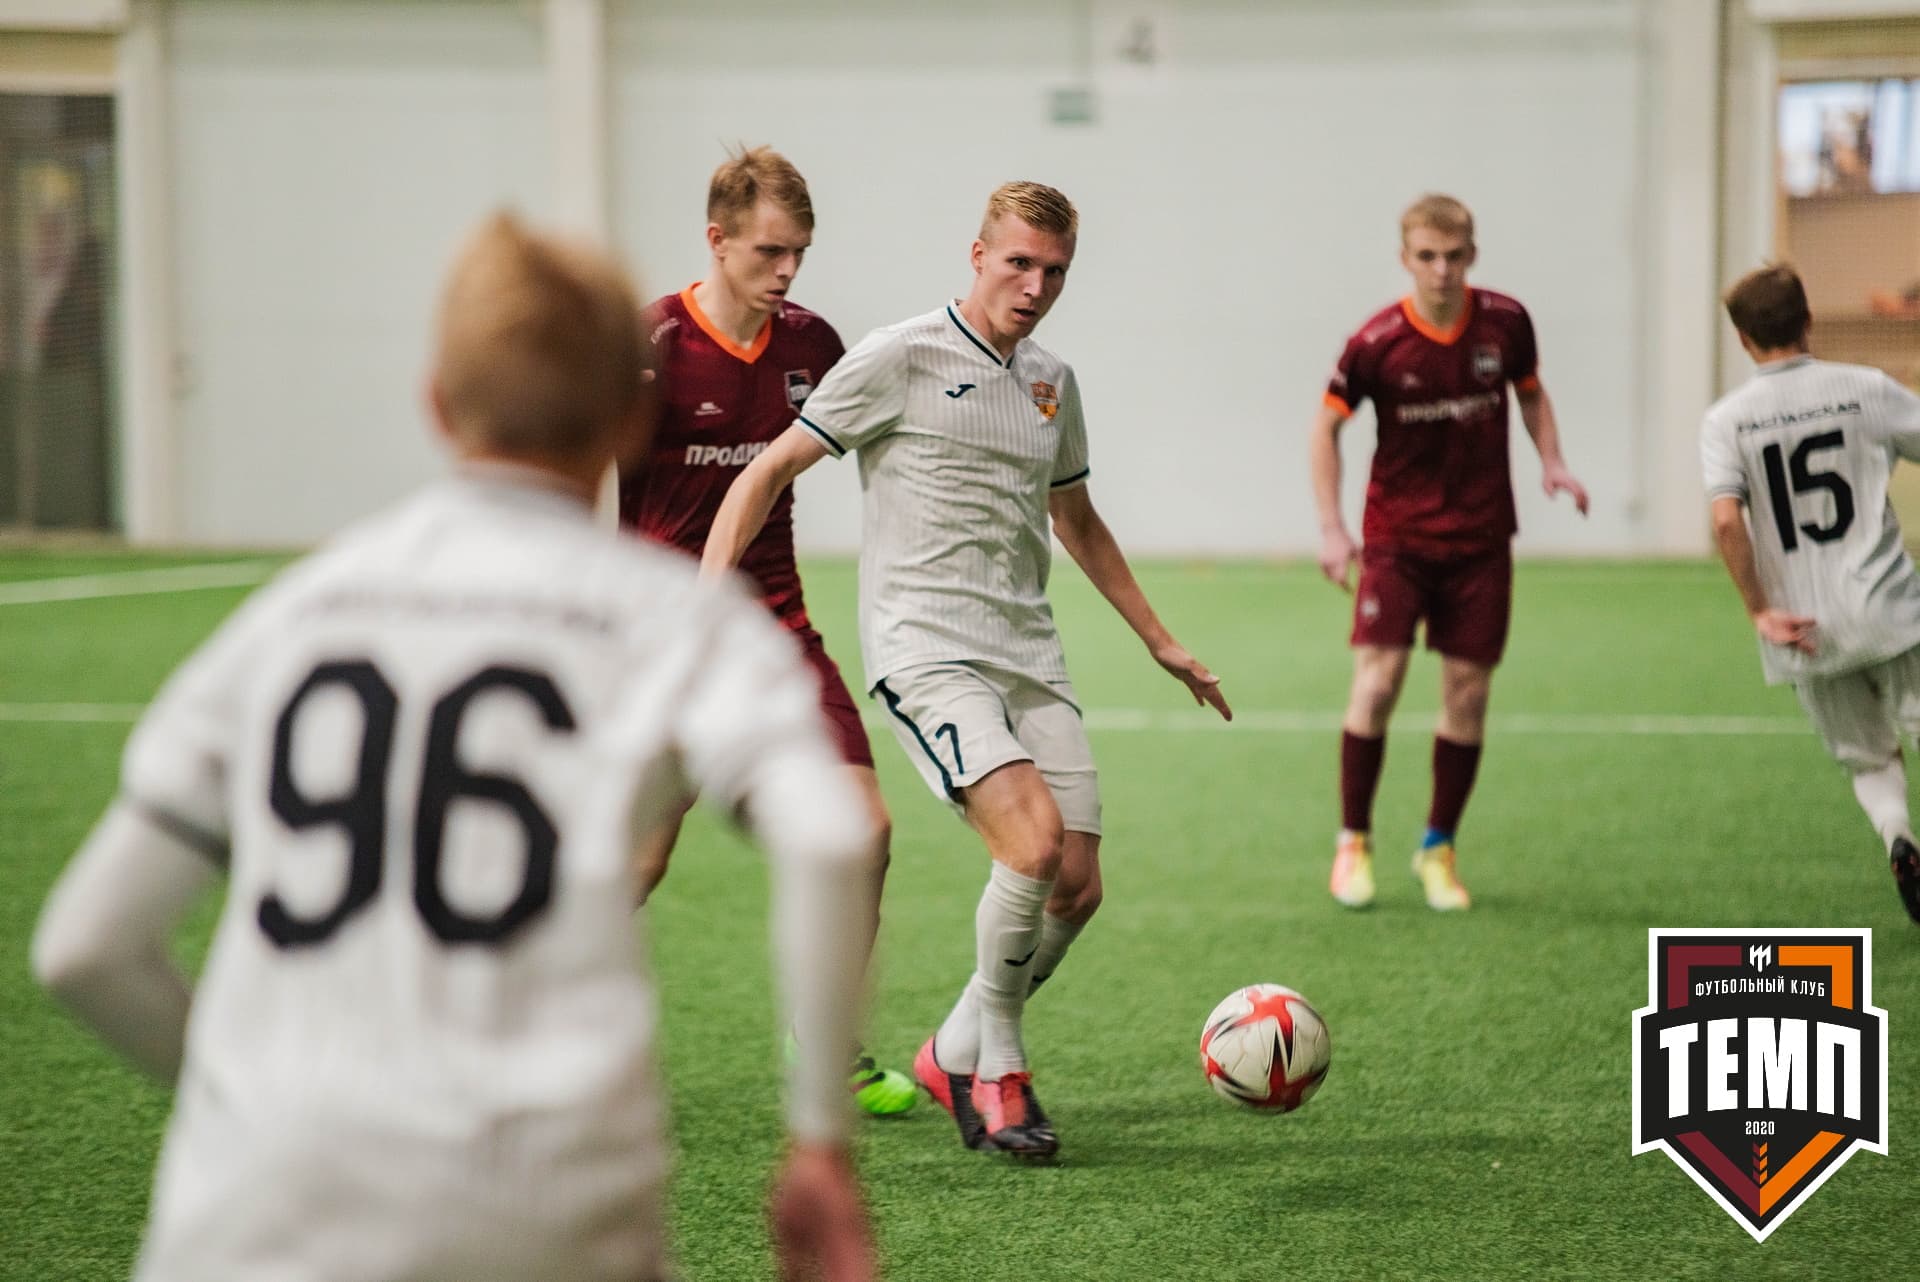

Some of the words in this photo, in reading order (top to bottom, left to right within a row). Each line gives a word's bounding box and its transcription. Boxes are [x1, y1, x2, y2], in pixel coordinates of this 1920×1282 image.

[685, 442, 769, 466] ПРОДИ
[1763, 429, 1855, 553] 15
[935, 722, 965, 775] 7
[257, 659, 576, 948] 96
